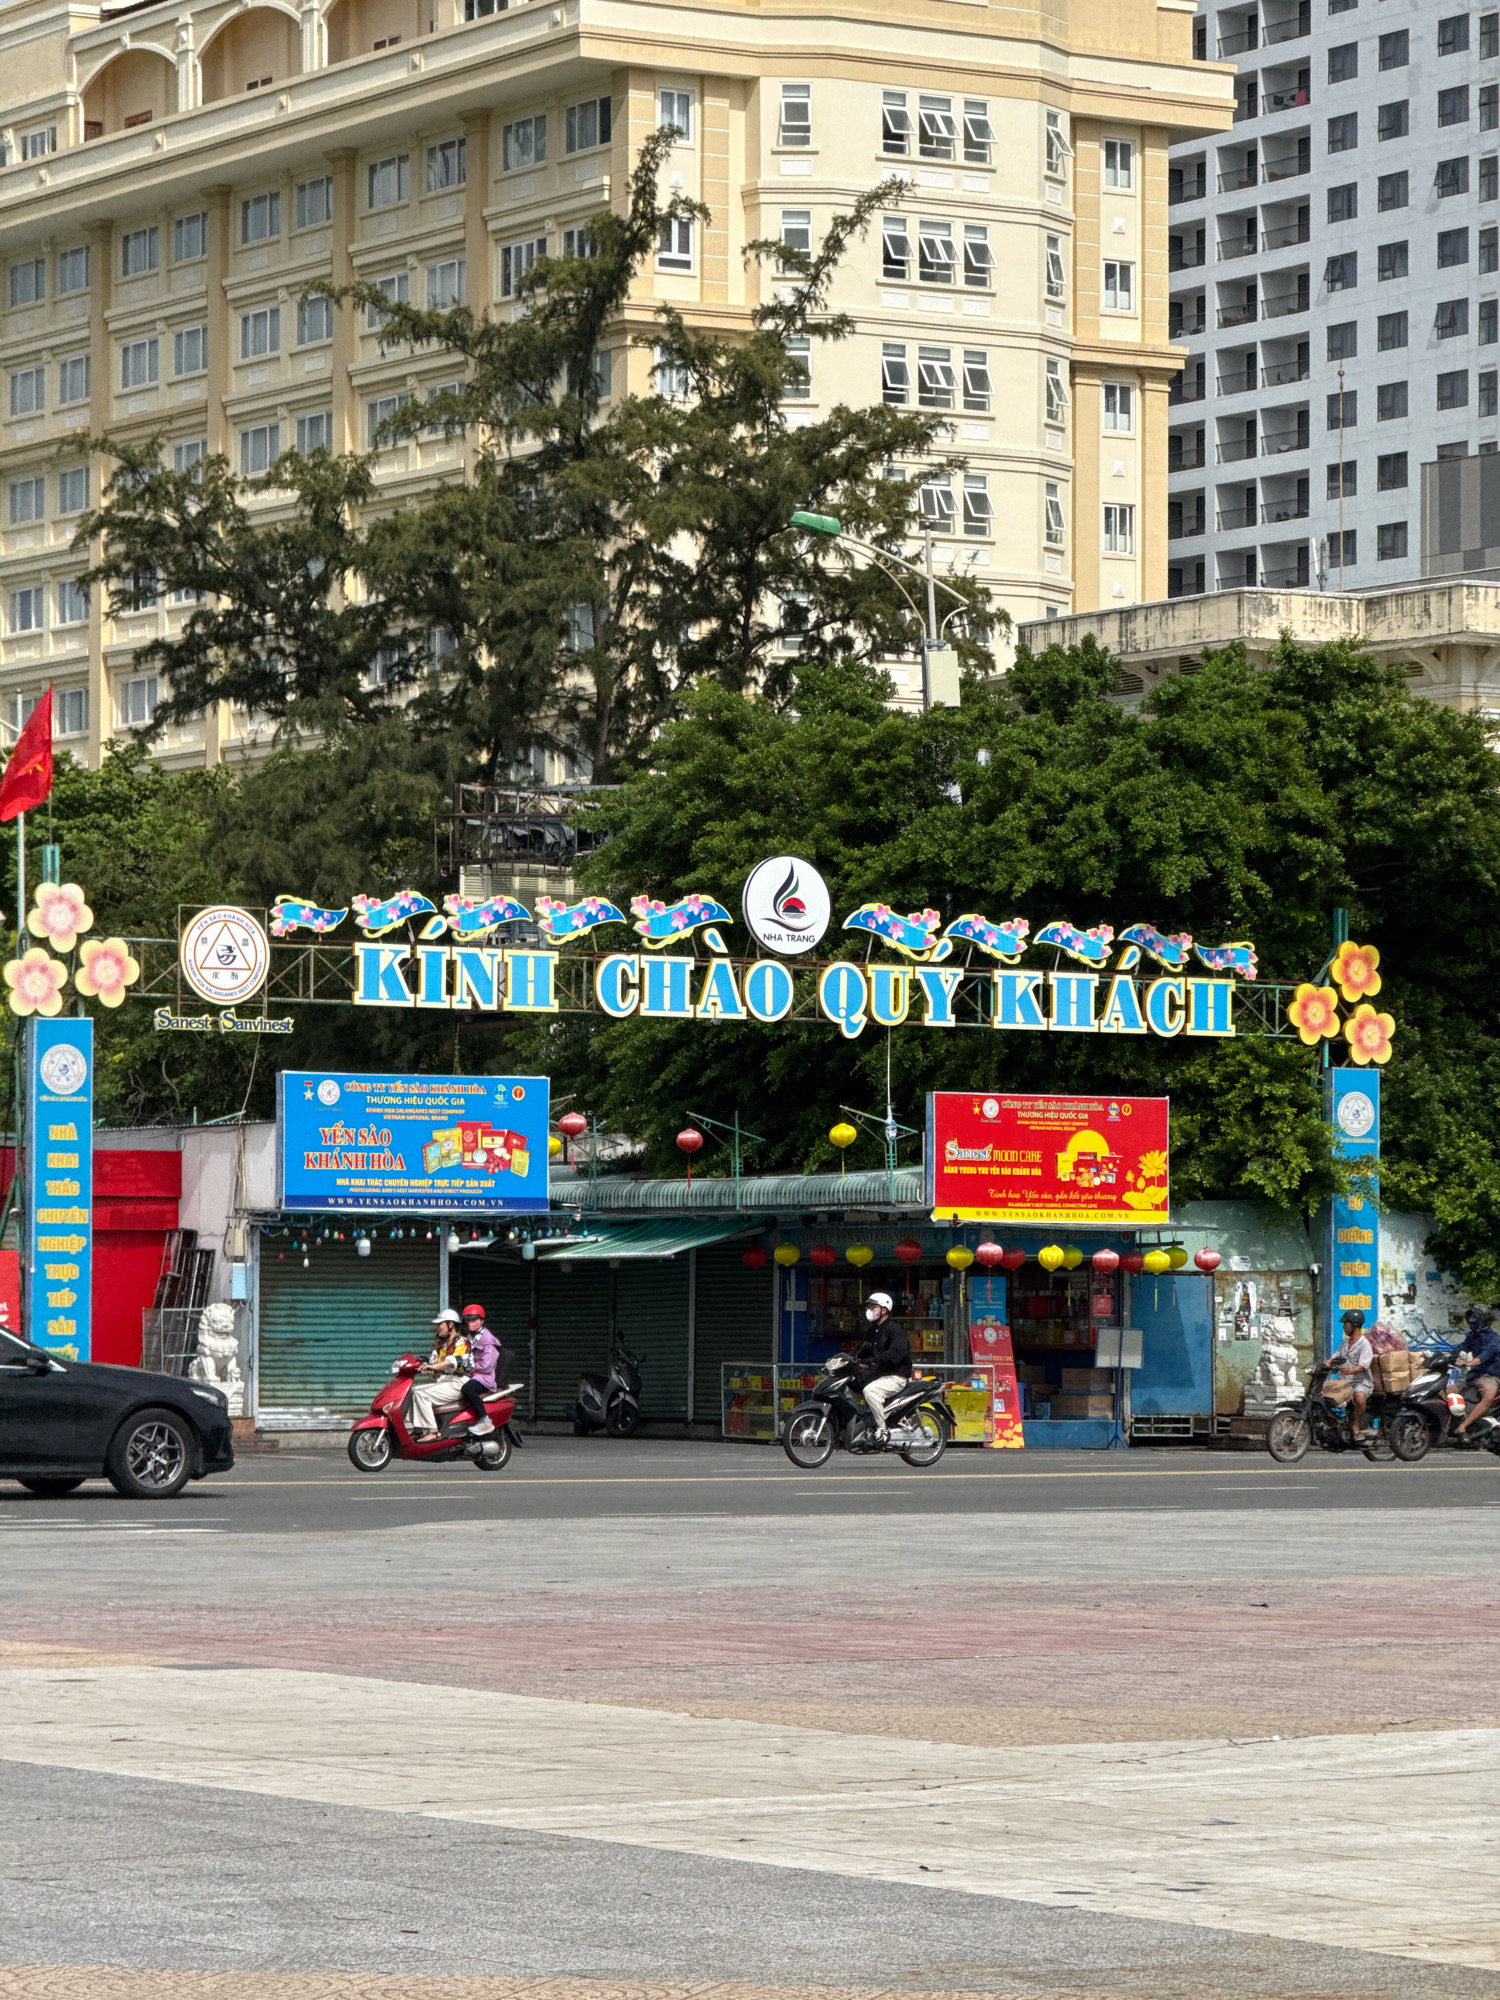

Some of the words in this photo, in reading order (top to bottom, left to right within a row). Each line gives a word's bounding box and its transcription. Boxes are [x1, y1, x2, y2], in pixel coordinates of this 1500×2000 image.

[763, 933, 783, 942] NHA
[786, 934, 816, 943] TRANG
[250, 961, 263, 986] COMPANY
[353, 914, 559, 1012] KÍNH
[594, 928, 794, 1022] CHÀO
[818, 937, 965, 1039] QUÝ
[991, 945, 1236, 1038] KHÁCH
[156, 1007, 212, 1030] Sanest
[221, 1008, 293, 1033] Sanvinest
[344, 1080, 372, 1092] CÔNG
[373, 1083, 386, 1093] TY
[388, 1080, 409, 1093] YẾN
[409, 1082, 429, 1094] SÀO
[430, 1082, 465, 1094] KHÁNH
[466, 1083, 487, 1094] HÒA
[366, 1095, 402, 1104] THƯƠNG
[404, 1096, 423, 1106] HIỆU
[425, 1095, 449, 1106] QUỐC
[451, 1097, 466, 1105] GIA
[1060, 1111, 1077, 1120] QUỐC
[1078, 1112, 1089, 1120] GIA
[49, 1122, 78, 1140] NHÀ
[319, 1120, 356, 1146] YẾN
[358, 1124, 392, 1146] SÀO
[304, 1147, 367, 1170] KHÁNH
[369, 1148, 406, 1171] HÒA
[945, 1140, 992, 1161] Sanest
[993, 1150, 1018, 1161] MOON
[1020, 1151, 1042, 1162] CAKE
[47, 1153, 79, 1168] KHAI
[46, 1178, 80, 1196] THÁC
[336, 1177, 349, 1186] NHÀ
[351, 1178, 365, 1186] KHAI
[367, 1177, 383, 1186] THÁC
[384, 1178, 408, 1187] CHUYÊN
[410, 1178, 432, 1188] NGHIỆP
[451, 1177, 464, 1187] TIẾP
[328, 1197, 504, 1207] WWW.YENSAOKHANHHOA.COM.VN
[1008, 1190, 1020, 1199] hoa
[1022, 1189, 1039, 1201] Yến
[1069, 1190, 1080, 1200] kết
[1081, 1192, 1093, 1202] yêu
[37, 1206, 89, 1224] CHUYÊN
[38, 1234, 87, 1255] NGHIỆP
[45, 1263, 79, 1282] TRỰC
[1340, 1259, 1370, 1276] THIÊN
[47, 1288, 77, 1307] TIẾP
[1339, 1293, 1371, 1310] NHIÊN
[47, 1315, 76, 1335] SẢN
